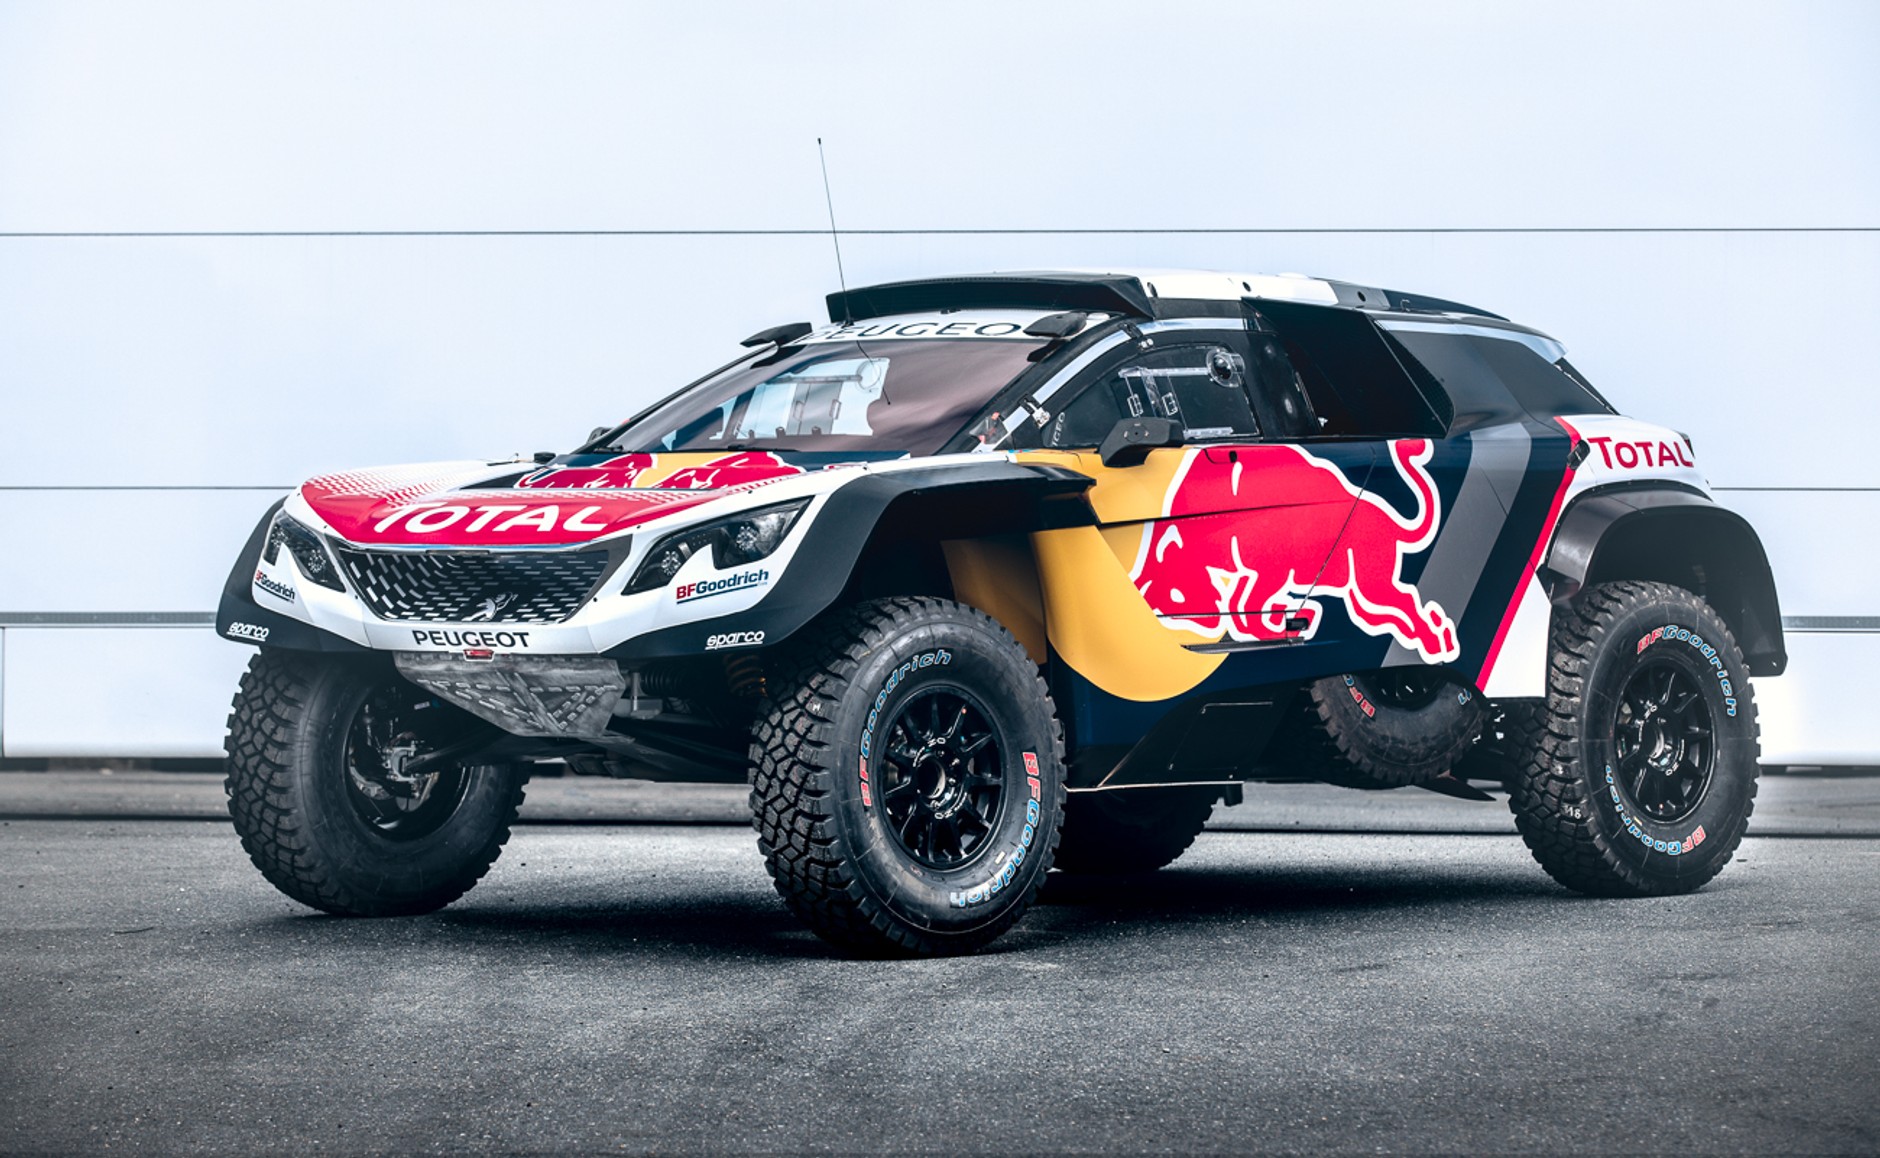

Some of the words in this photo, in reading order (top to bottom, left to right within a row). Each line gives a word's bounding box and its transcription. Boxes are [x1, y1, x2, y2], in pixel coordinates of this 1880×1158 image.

[1587, 437, 1694, 469] TOTAL
[374, 502, 608, 533] TOTAL
[256, 570, 295, 599] BFGoodrich
[676, 569, 769, 599] BFGoodrich
[229, 622, 269, 638] sparco
[412, 630, 529, 647] PEUGEOT
[705, 631, 765, 649] sparco
[1637, 625, 1736, 716] BFGoodrich
[859, 650, 951, 806] BFGoodrich
[1606, 765, 1706, 855] BFGoodrich
[950, 752, 1040, 907] BFGoodrich
